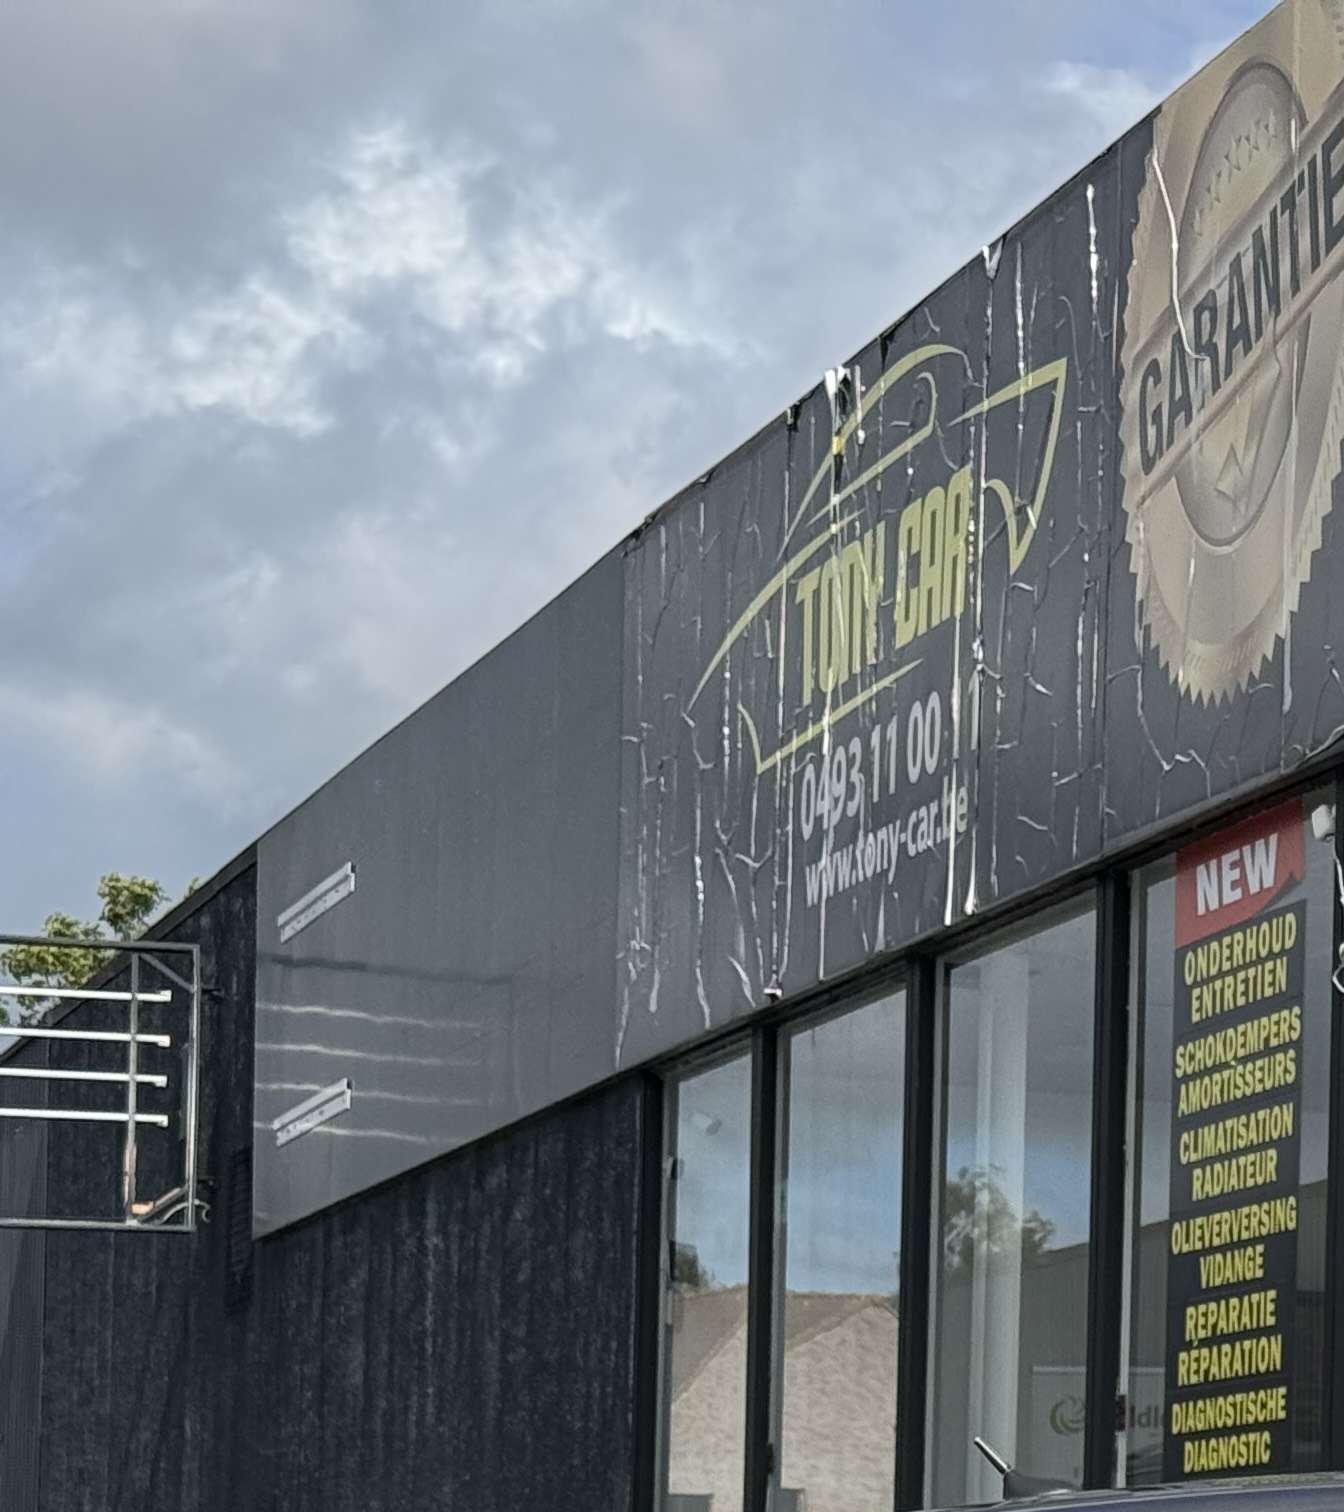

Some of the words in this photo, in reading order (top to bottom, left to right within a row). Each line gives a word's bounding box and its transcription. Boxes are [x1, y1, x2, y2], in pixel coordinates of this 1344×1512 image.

[796, 520, 886, 705] TONY
[895, 464, 972, 650] CAR
[801, 736, 864, 841] 0493
[870, 715, 897, 803] 11
[907, 691, 942, 784] 00
[1196, 832, 1279, 917] NEW
[1184, 912, 1297, 986] ONDERHOUD
[1190, 957, 1287, 1023] ENTRETIEN
[1175, 1006, 1301, 1079] SCHOKDEMPERS
[1178, 1049, 1297, 1117] AMORTISSEURS
[1179, 1102, 1294, 1166] CLIMATISATION
[1192, 1147, 1278, 1201] RADIATEUR
[1171, 1195, 1297, 1254] OLIEVERVERSING
[1199, 1243, 1265, 1290] VIDANGE
[1185, 1290, 1277, 1341] REPARATIE
[1171, 1386, 1286, 1438] DIAGNOSTISCHE
[1183, 1431, 1271, 1473] DIAGNOSTIC
